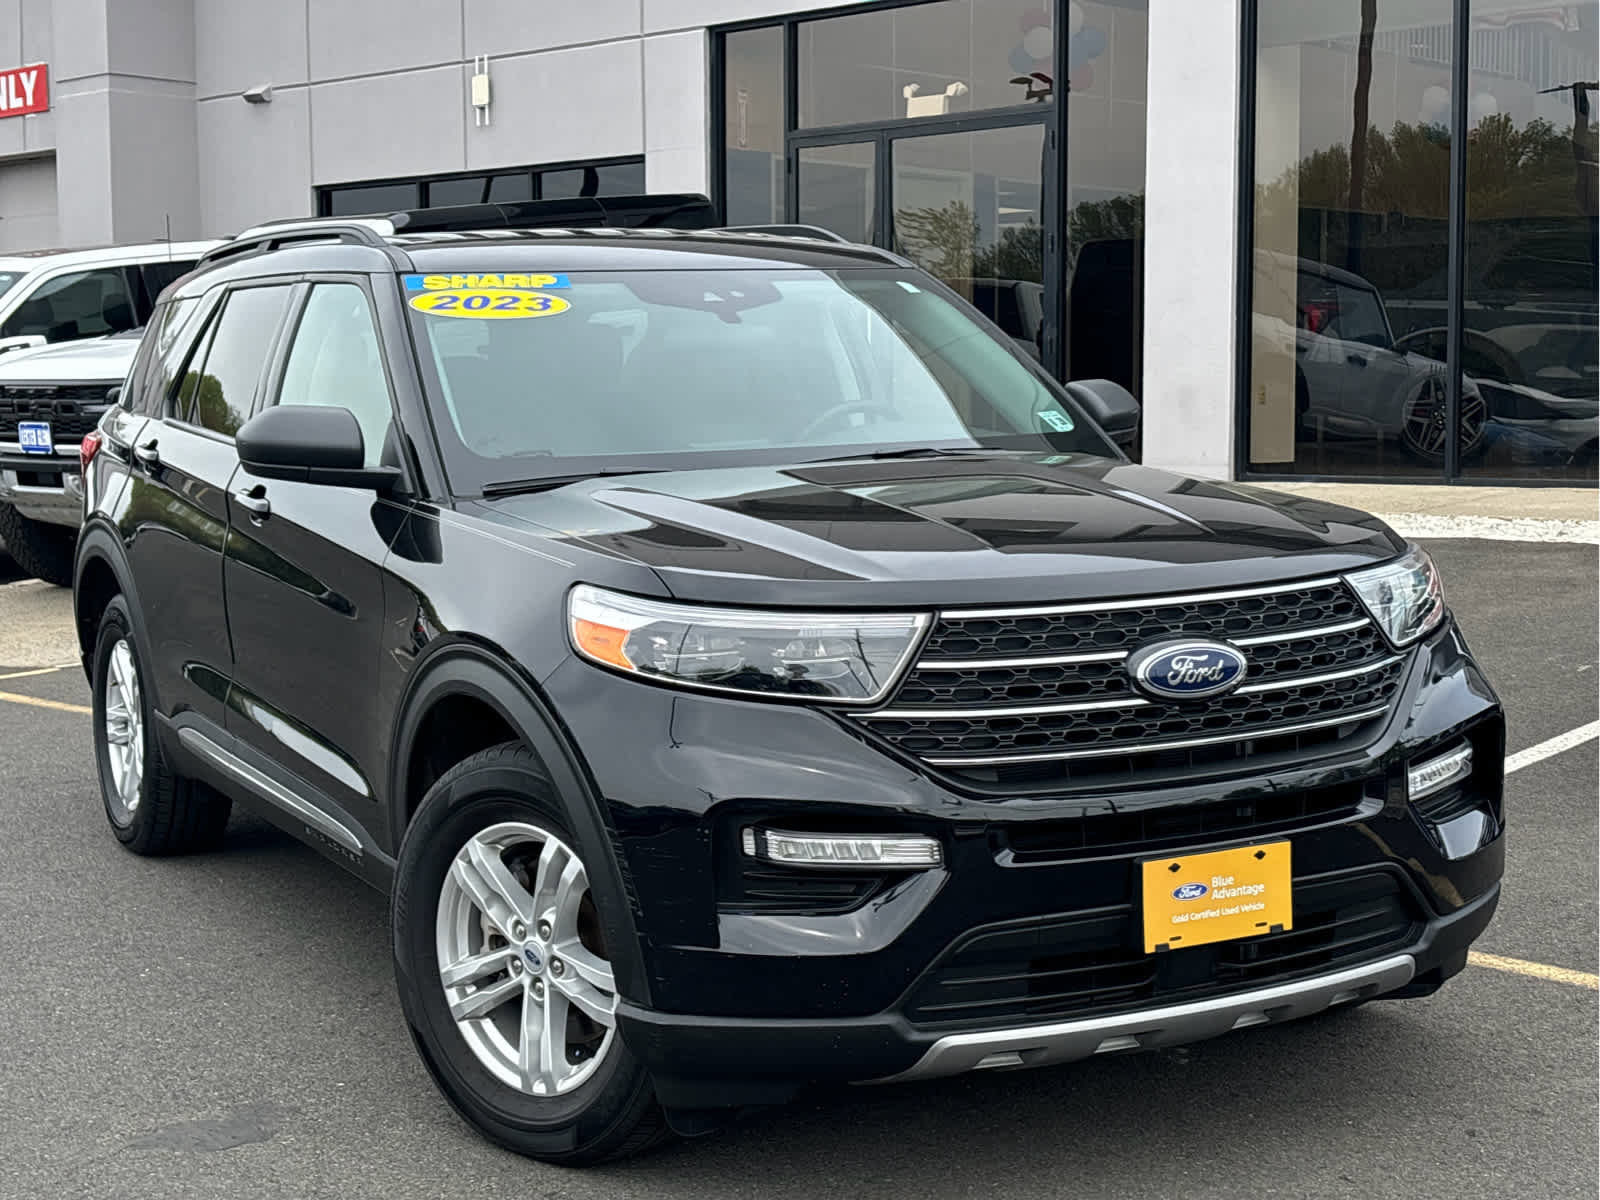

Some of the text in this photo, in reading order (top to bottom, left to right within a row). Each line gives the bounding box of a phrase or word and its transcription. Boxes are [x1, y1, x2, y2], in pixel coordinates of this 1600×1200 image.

[422, 274, 558, 290] SHARP
[430, 295, 553, 312] 2023
[1167, 654, 1224, 686] Ford
[1211, 875, 1235, 888] Blue
[1178, 885, 1202, 898] Ford
[1211, 883, 1265, 900] Advantage
[1171, 902, 1265, 923] Gold Certified Used Vehicle
